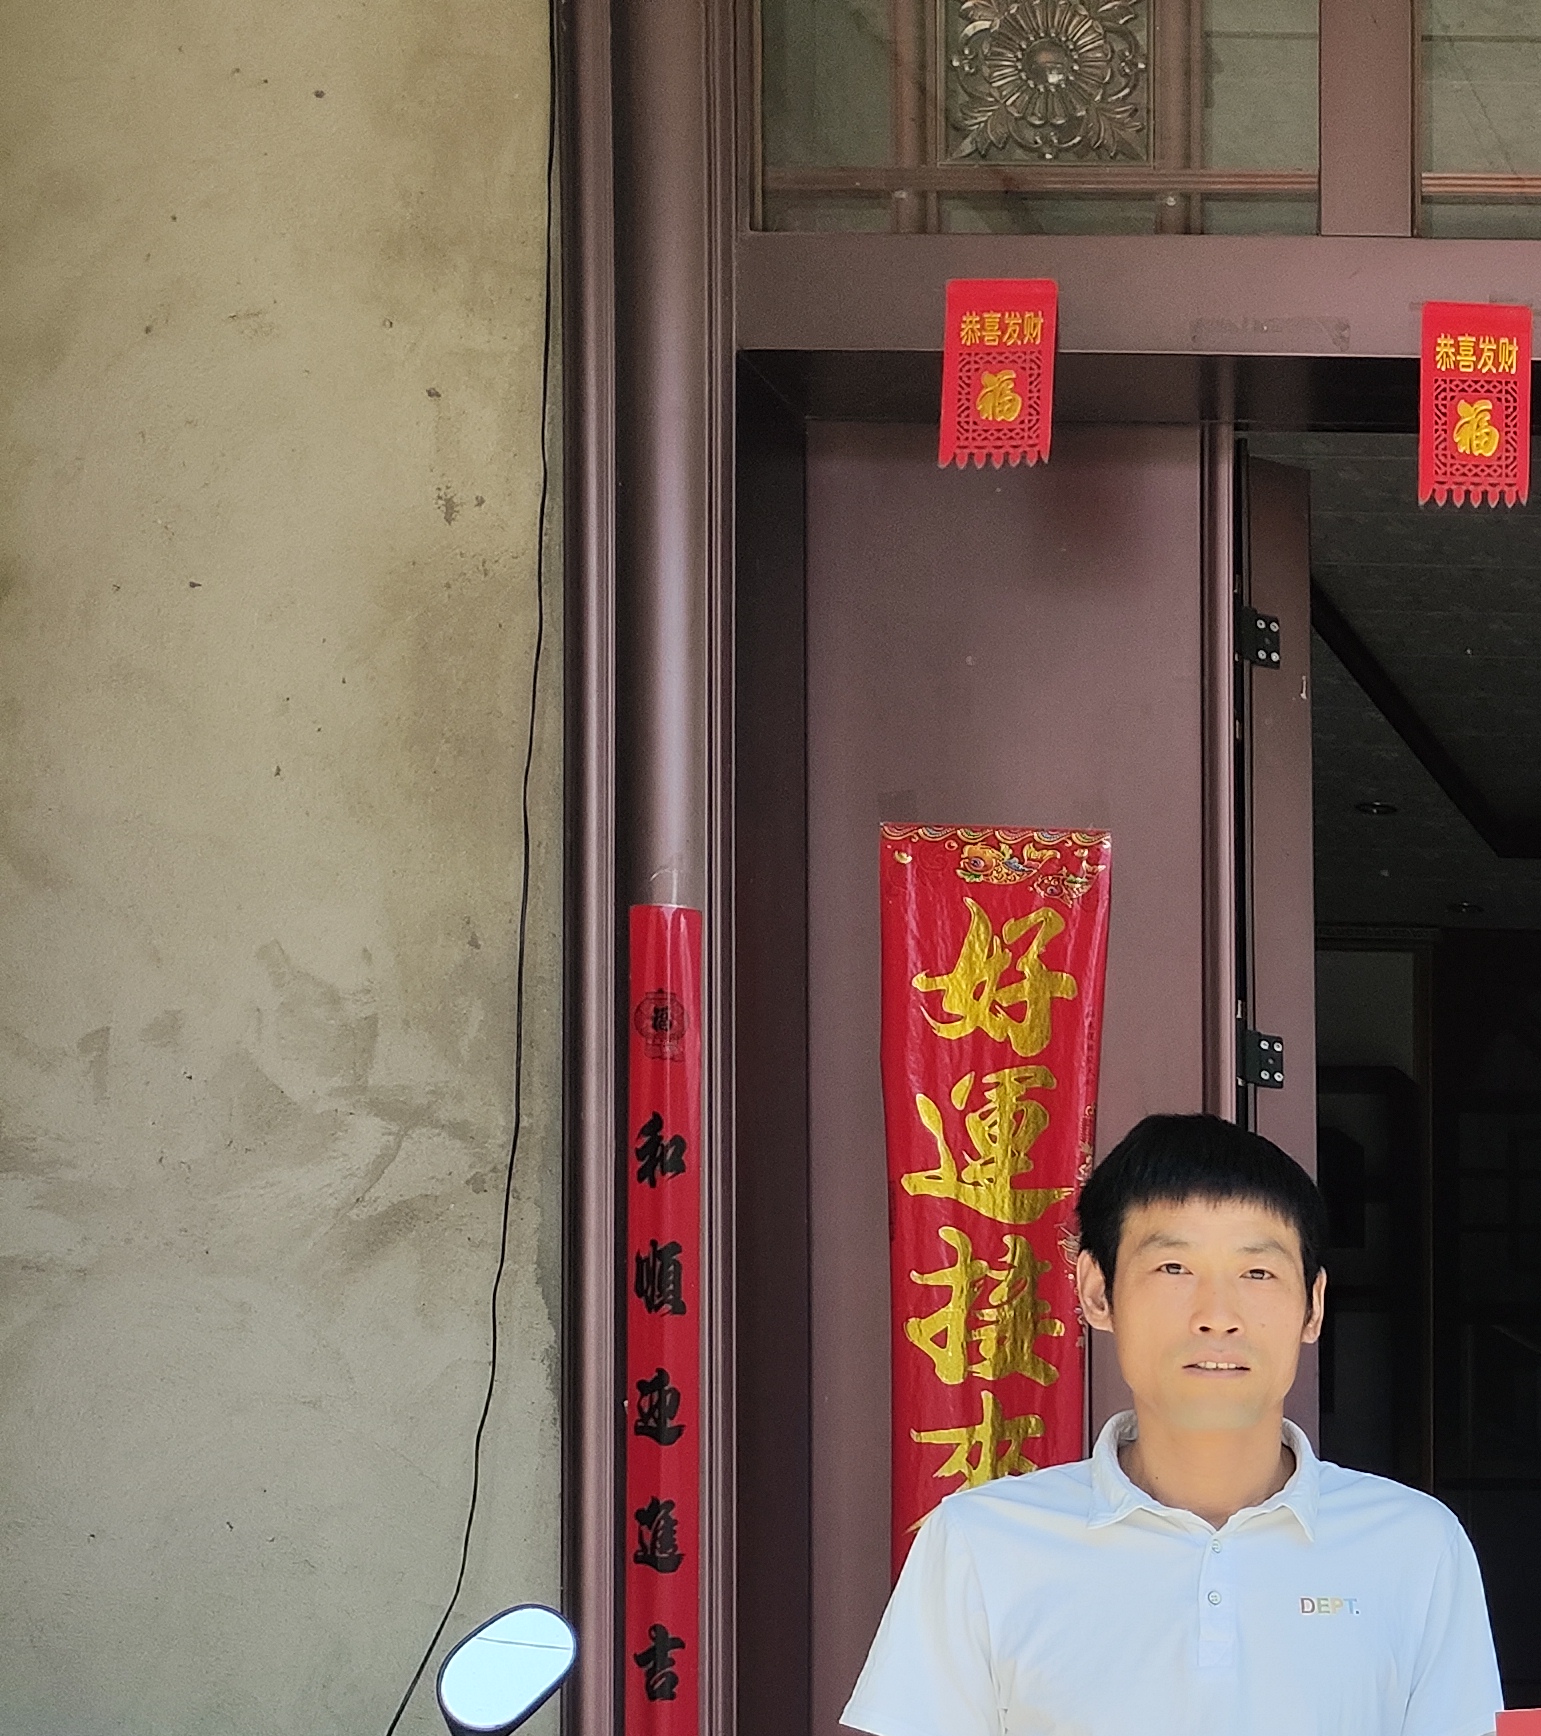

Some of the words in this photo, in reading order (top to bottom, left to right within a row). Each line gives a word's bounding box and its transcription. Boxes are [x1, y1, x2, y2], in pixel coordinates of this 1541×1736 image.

[961, 310, 1043, 347] 恭喜发财
[1435, 334, 1518, 375] 恭喜发财
[976, 369, 1023, 422] 福
[1453, 399, 1500, 458] 福
[1300, 1597, 1360, 1615] DEPT.
